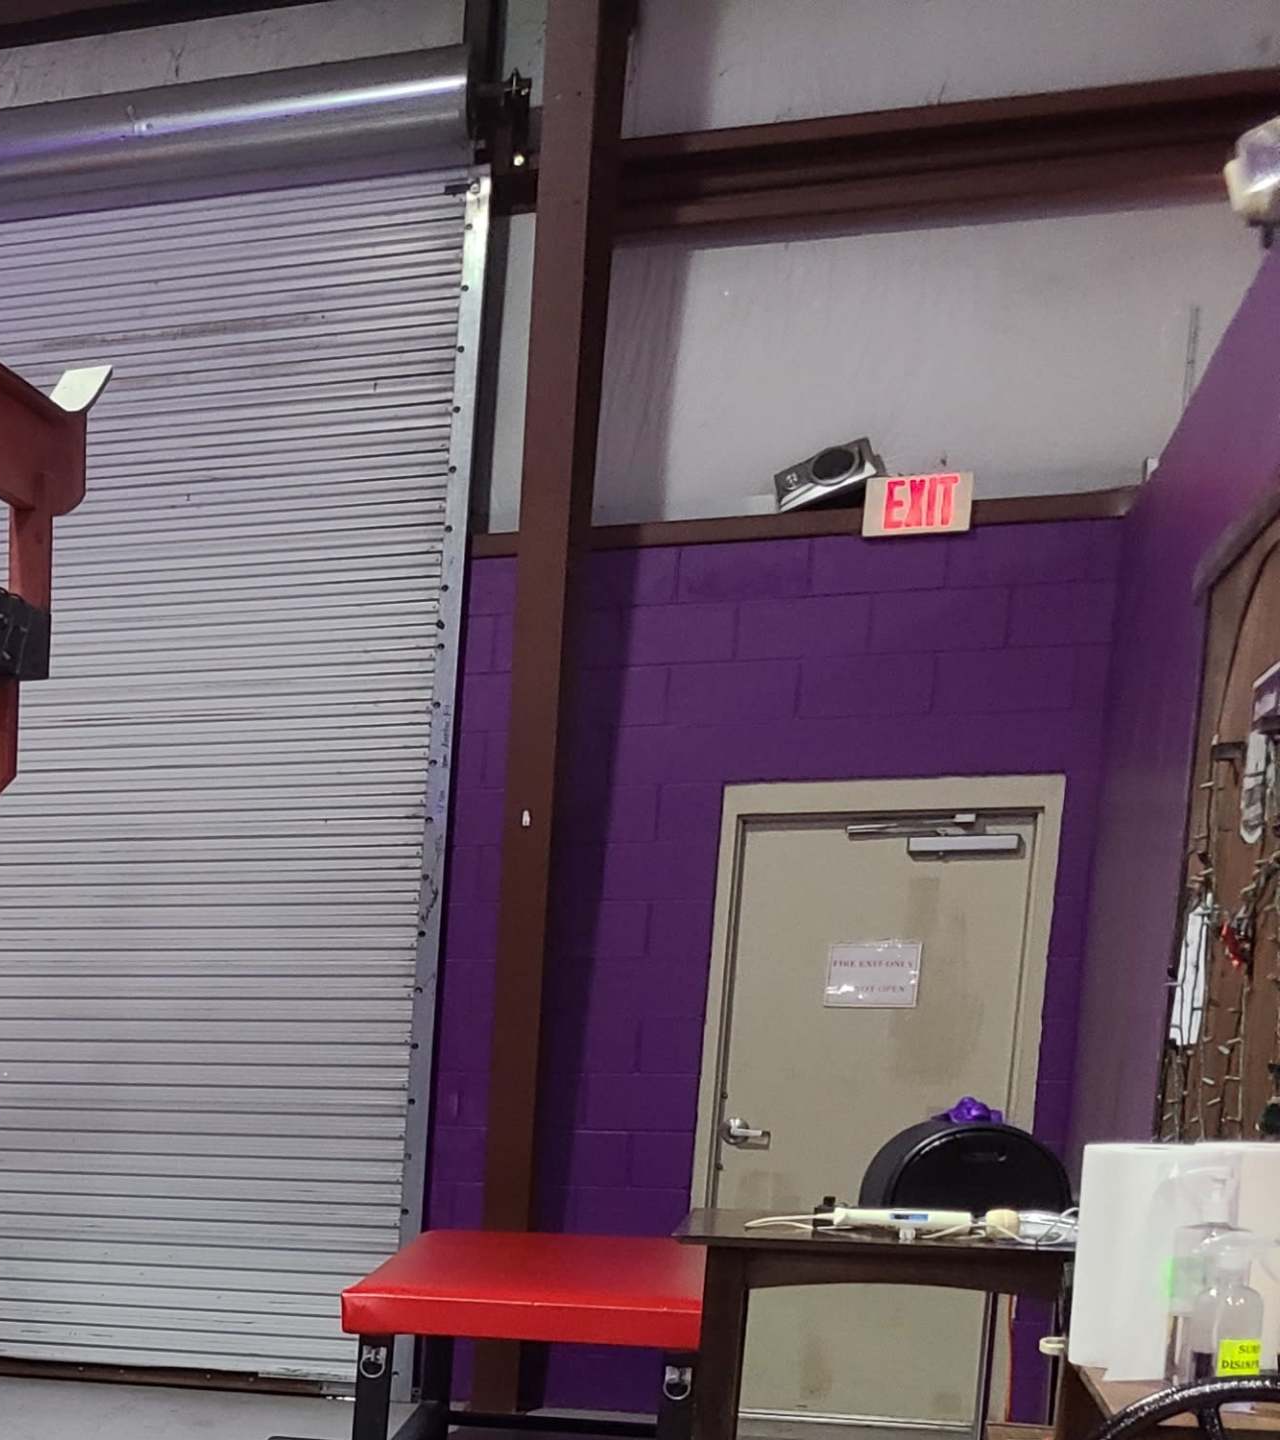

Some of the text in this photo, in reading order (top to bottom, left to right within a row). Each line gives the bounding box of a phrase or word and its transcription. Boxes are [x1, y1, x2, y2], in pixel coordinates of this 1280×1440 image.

[883, 473, 960, 531] EXIT
[833, 959, 913, 968] FIRE EXIT ONLY
[878, 985, 905, 993] OPEN
